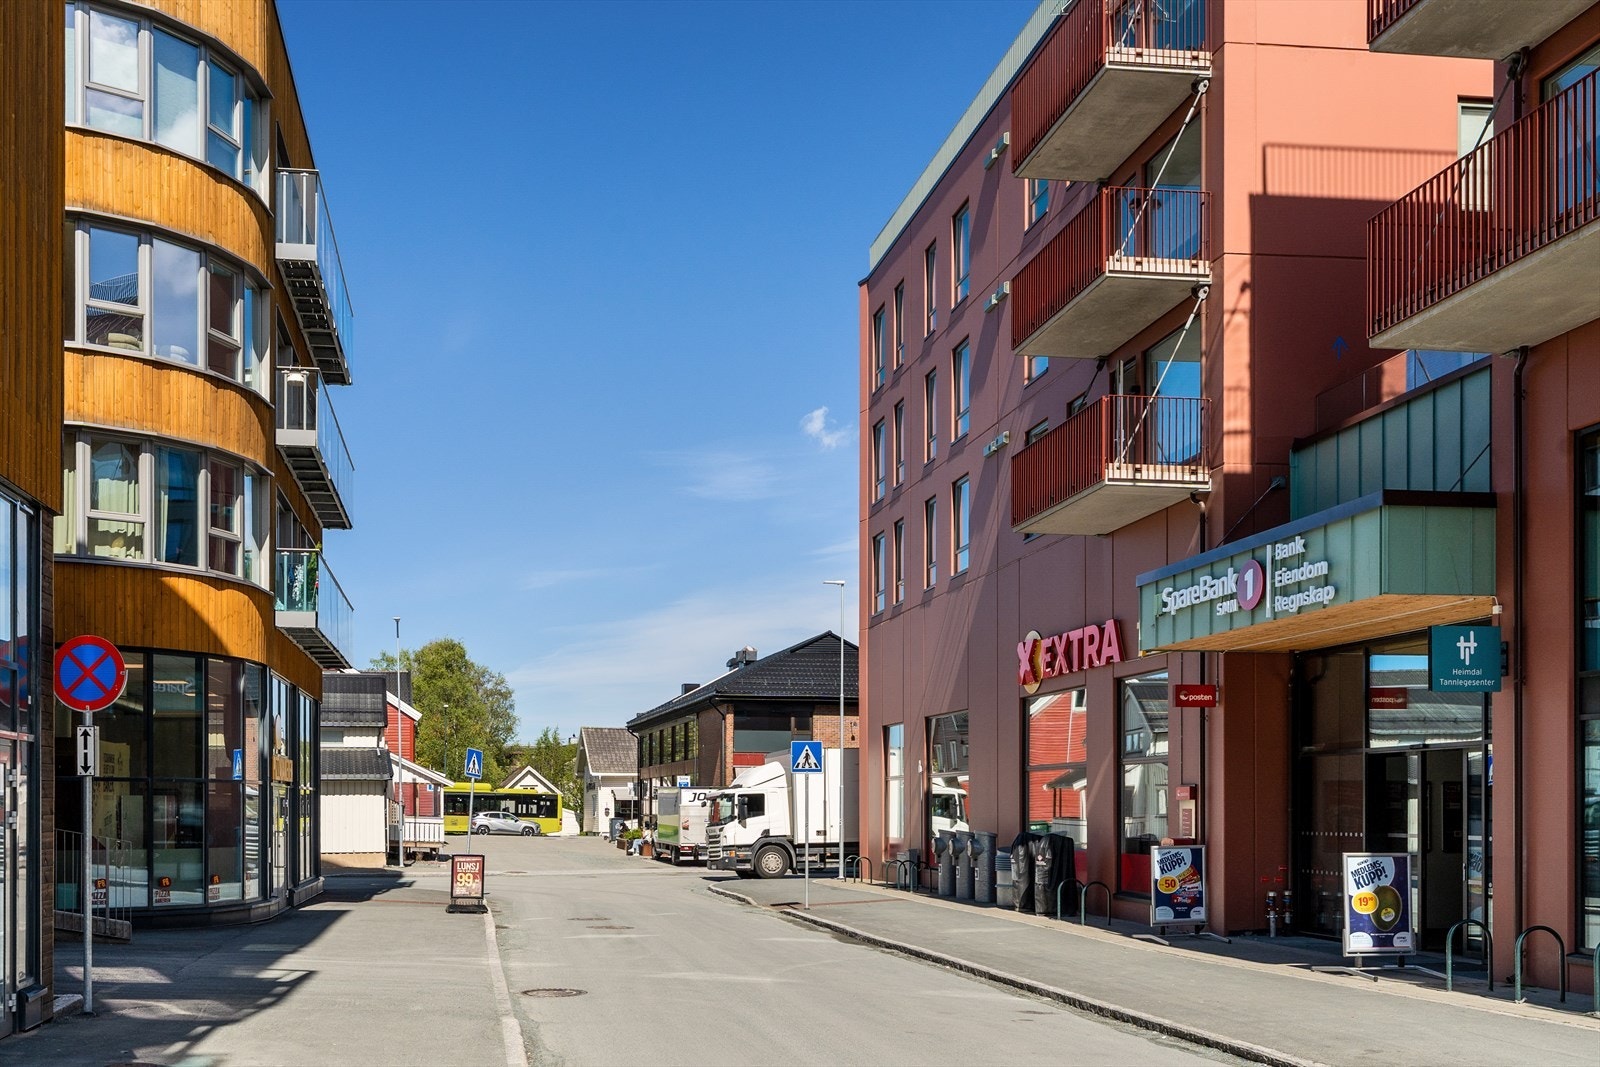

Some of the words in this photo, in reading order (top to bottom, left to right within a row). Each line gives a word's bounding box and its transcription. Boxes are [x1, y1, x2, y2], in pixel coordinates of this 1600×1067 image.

[1275, 536, 1306, 560] Bank
[1275, 561, 1328, 588] Eiendom
[1162, 567, 1239, 615] SpareBank
[1244, 568, 1254, 601] 1
[1274, 585, 1335, 613] Regnskap
[1041, 619, 1124, 679] EXTRA
[1440, 678, 1495, 688] Tannlegesenter
[1452, 668, 1482, 676] Heimdal
[1189, 693, 1212, 701] posten
[1157, 851, 1183, 866] MEDLEMS-
[1159, 855, 1187, 875] KUPP!
[1351, 860, 1382, 878] MEDLEMS-
[1354, 866, 1387, 890] KUPP!
